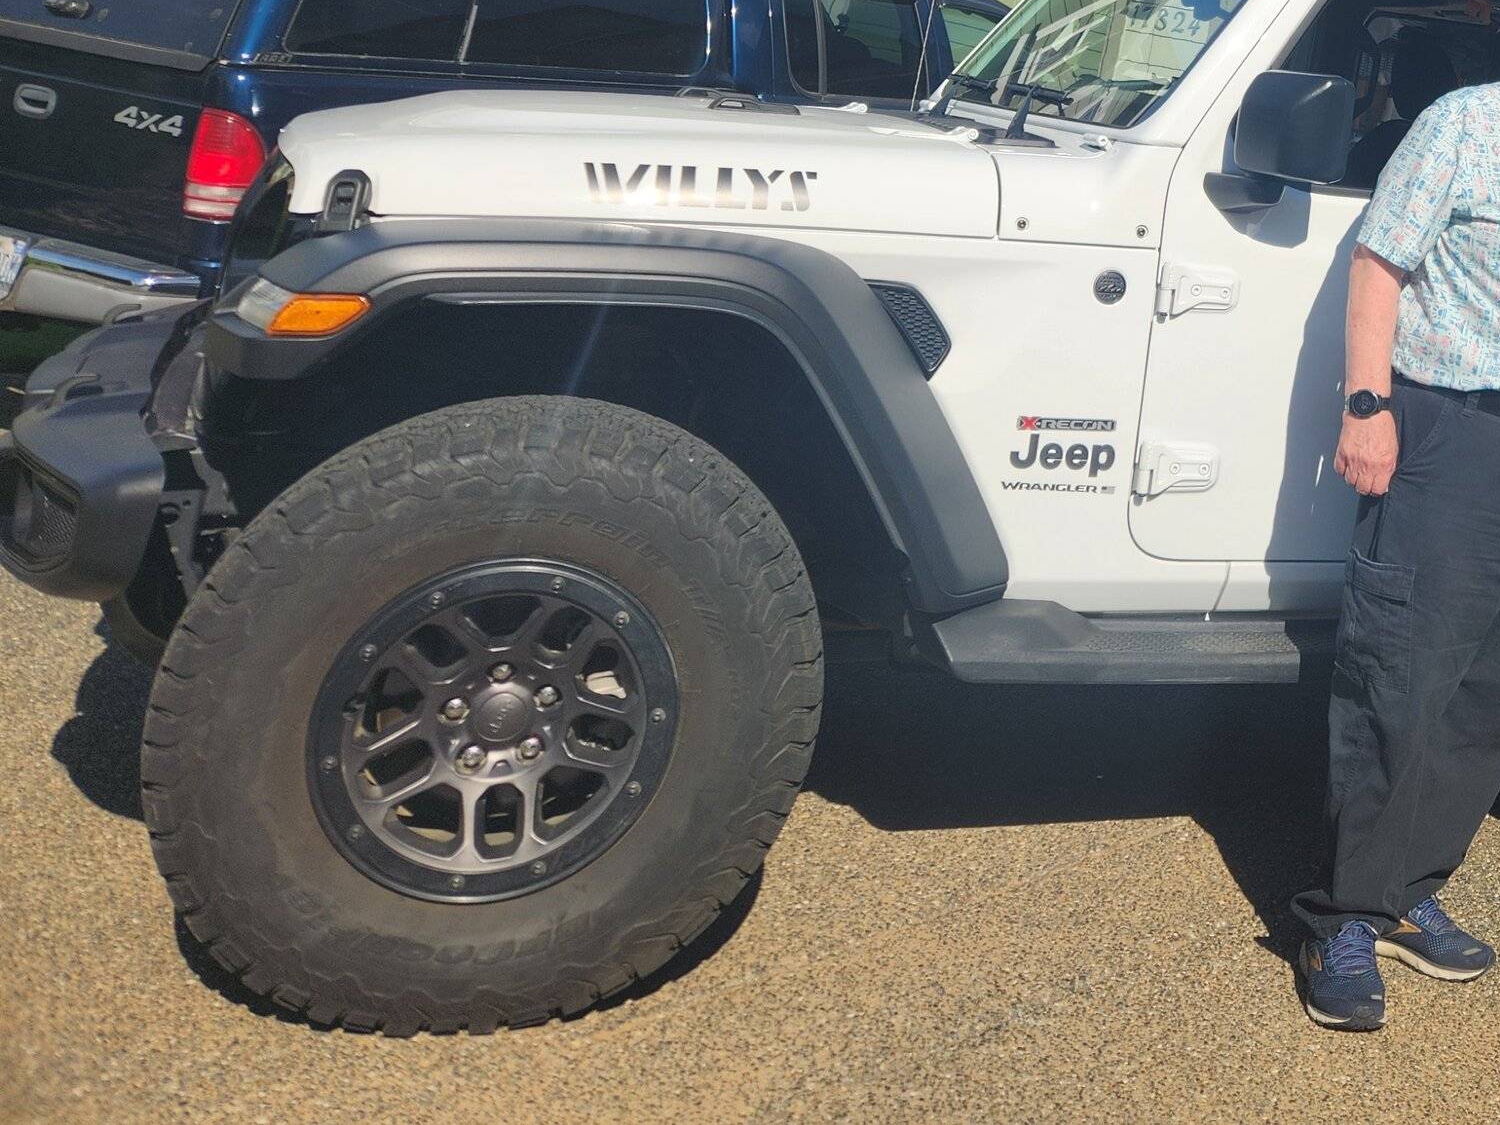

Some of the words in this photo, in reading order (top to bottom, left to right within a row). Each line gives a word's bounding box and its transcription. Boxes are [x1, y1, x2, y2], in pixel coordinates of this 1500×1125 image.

[583, 161, 818, 212] WILLYS
[1018, 416, 1113, 432] X-RECON
[1009, 433, 1116, 478] Jeep
[1001, 481, 1098, 494] WRANGLER
